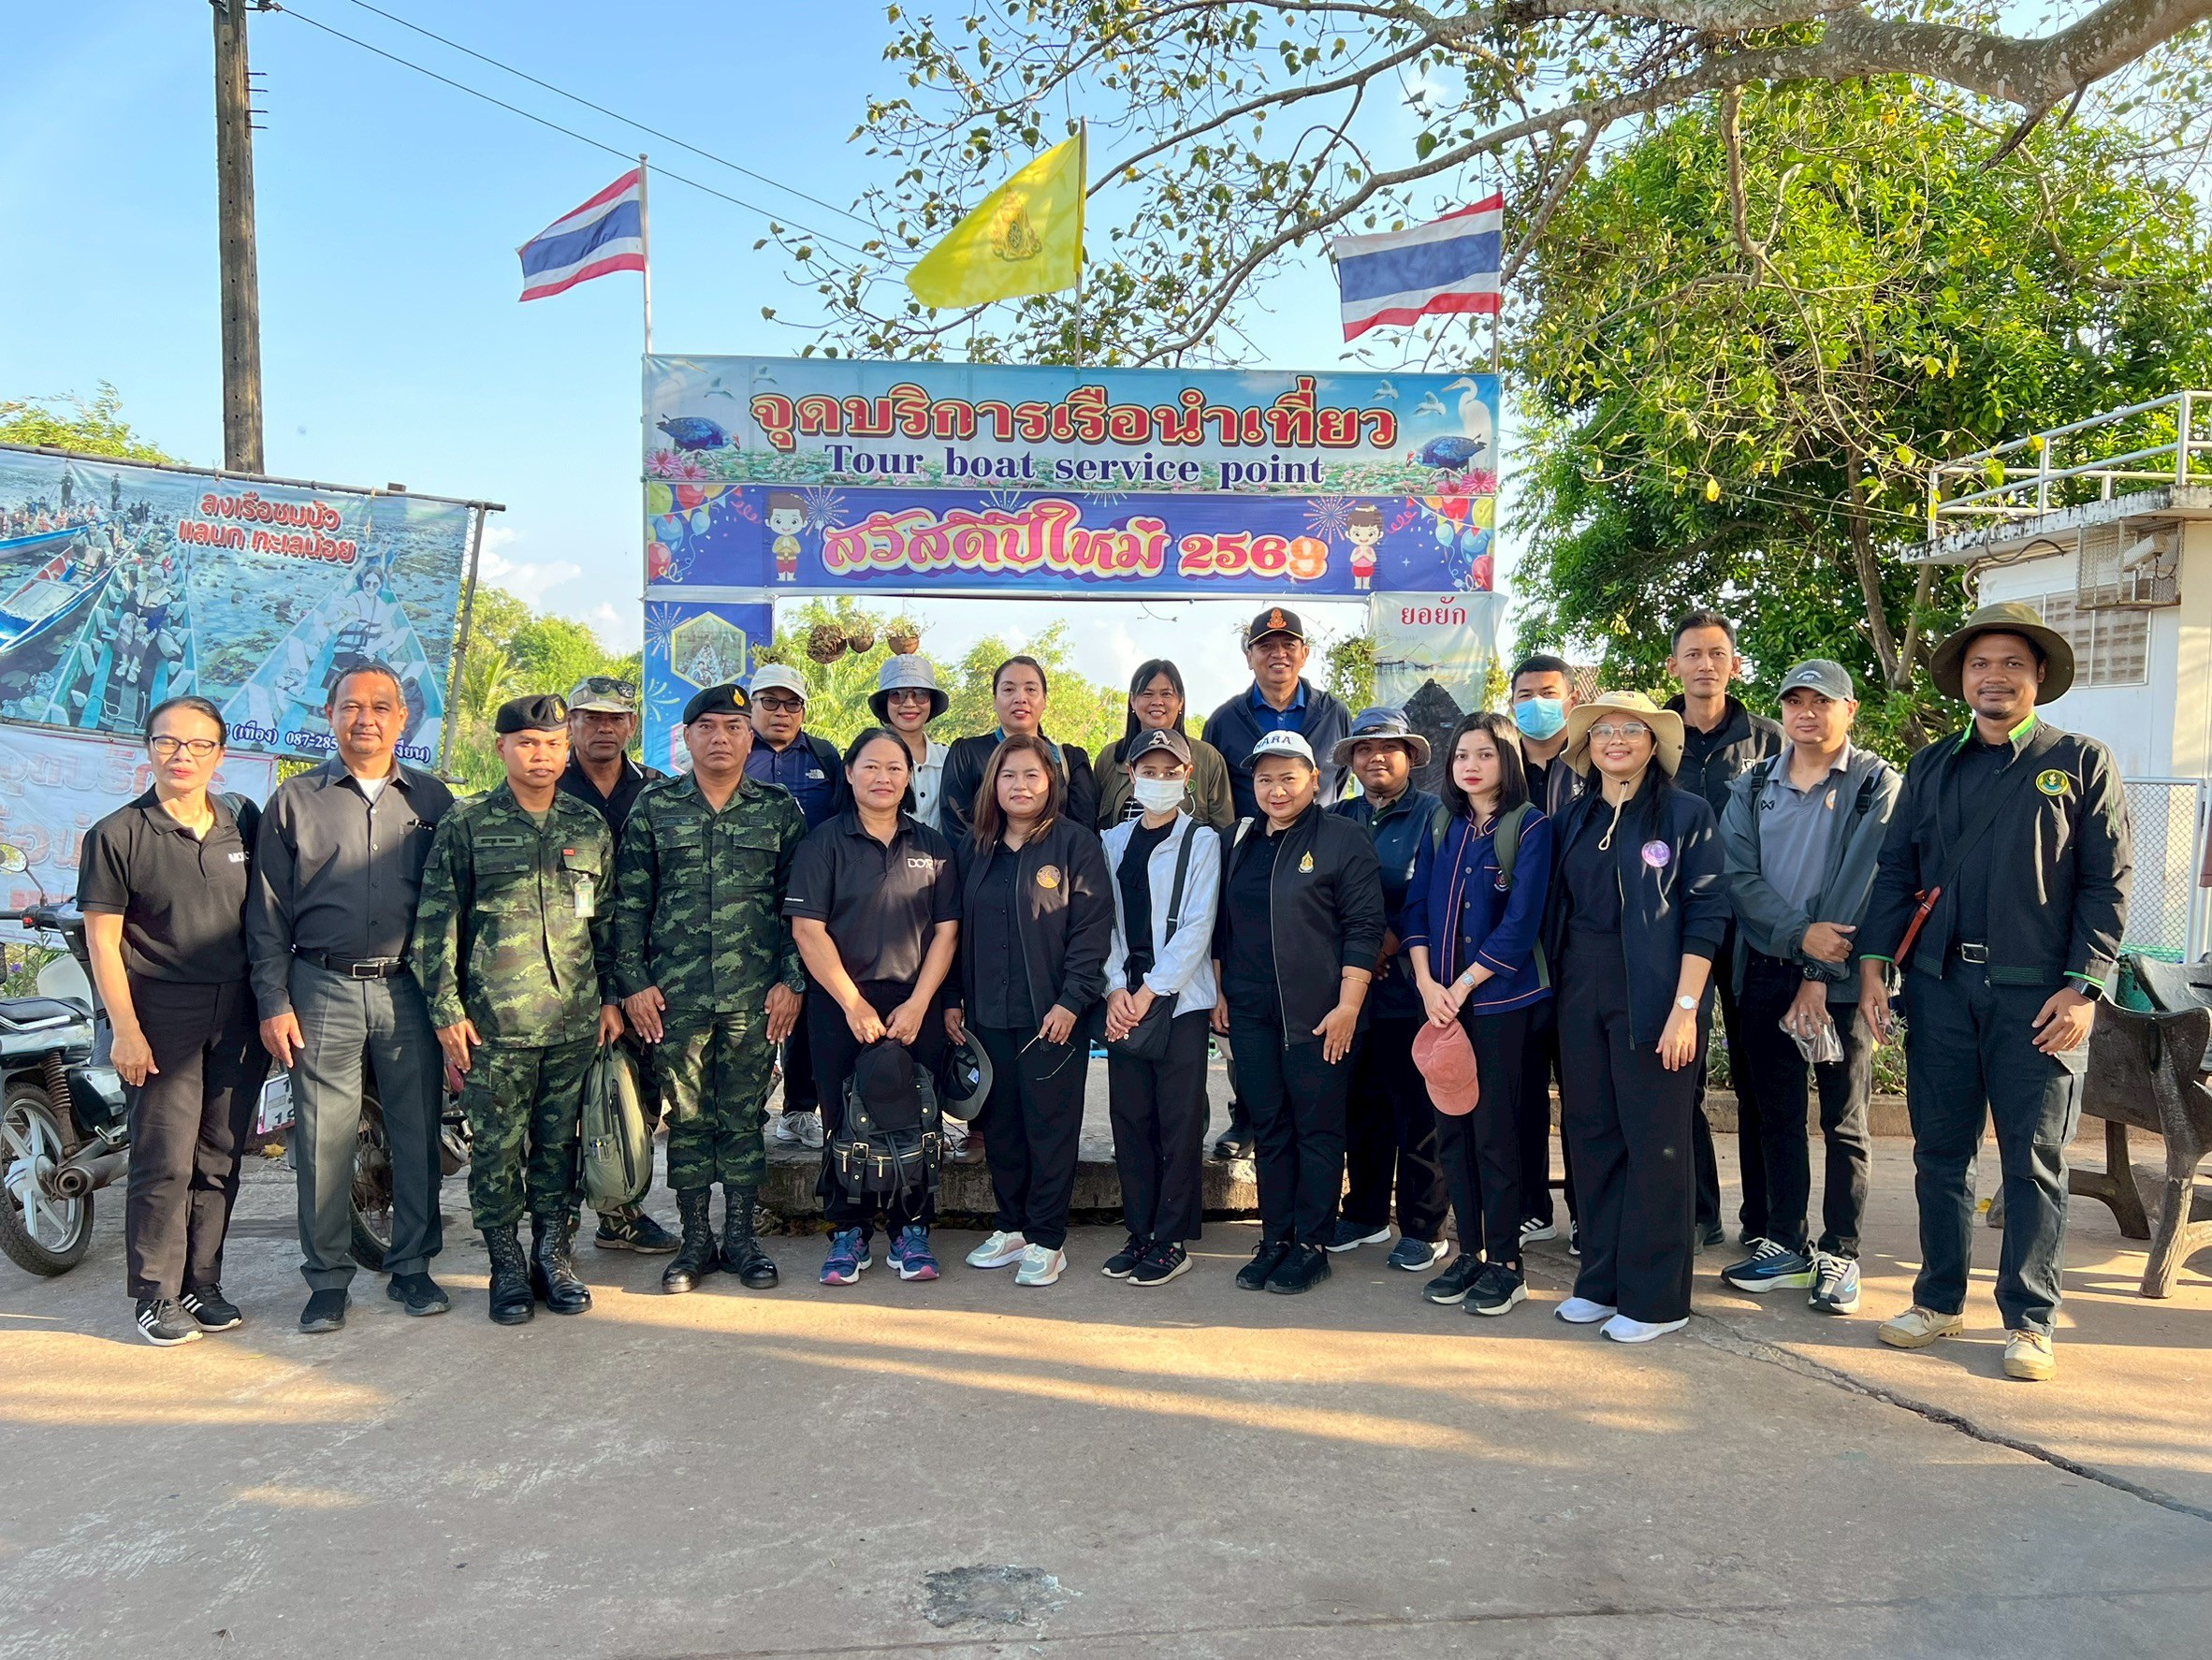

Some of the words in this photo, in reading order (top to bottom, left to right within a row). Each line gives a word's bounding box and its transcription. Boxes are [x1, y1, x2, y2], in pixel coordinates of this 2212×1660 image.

[749, 375, 1398, 453] จุดบริการเรือนำเที่ยว
[825, 444, 924, 476] Tour
[943, 446, 1036, 480] boat
[1055, 453, 1200, 484] service
[1219, 453, 1326, 489] point
[200, 491, 342, 531] ลงเรือชมบัว
[178, 520, 245, 550] แลนก
[251, 529, 357, 565] ทะเลน้อย
[822, 500, 1173, 574] สวัสดีปีใหม่
[1401, 595, 1466, 625] ยอยัก
